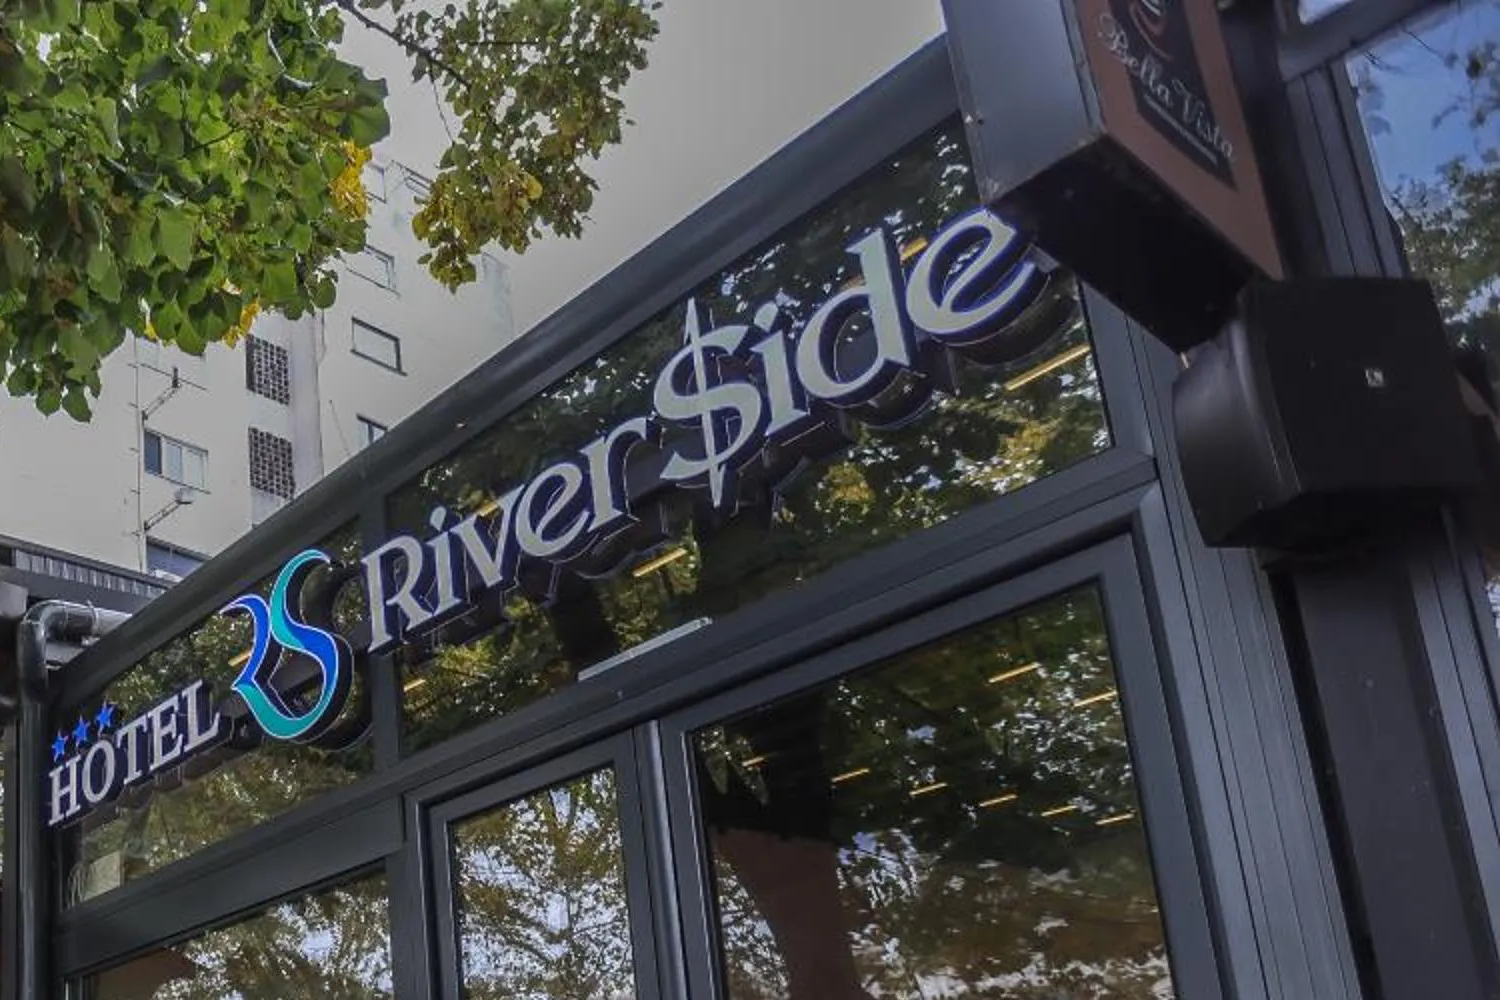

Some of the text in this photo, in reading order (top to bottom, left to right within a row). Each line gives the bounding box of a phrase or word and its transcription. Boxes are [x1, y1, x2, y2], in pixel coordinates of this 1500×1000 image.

[1099, 13, 1233, 164] Bella Vista
[48, 680, 220, 826] HOTEL
